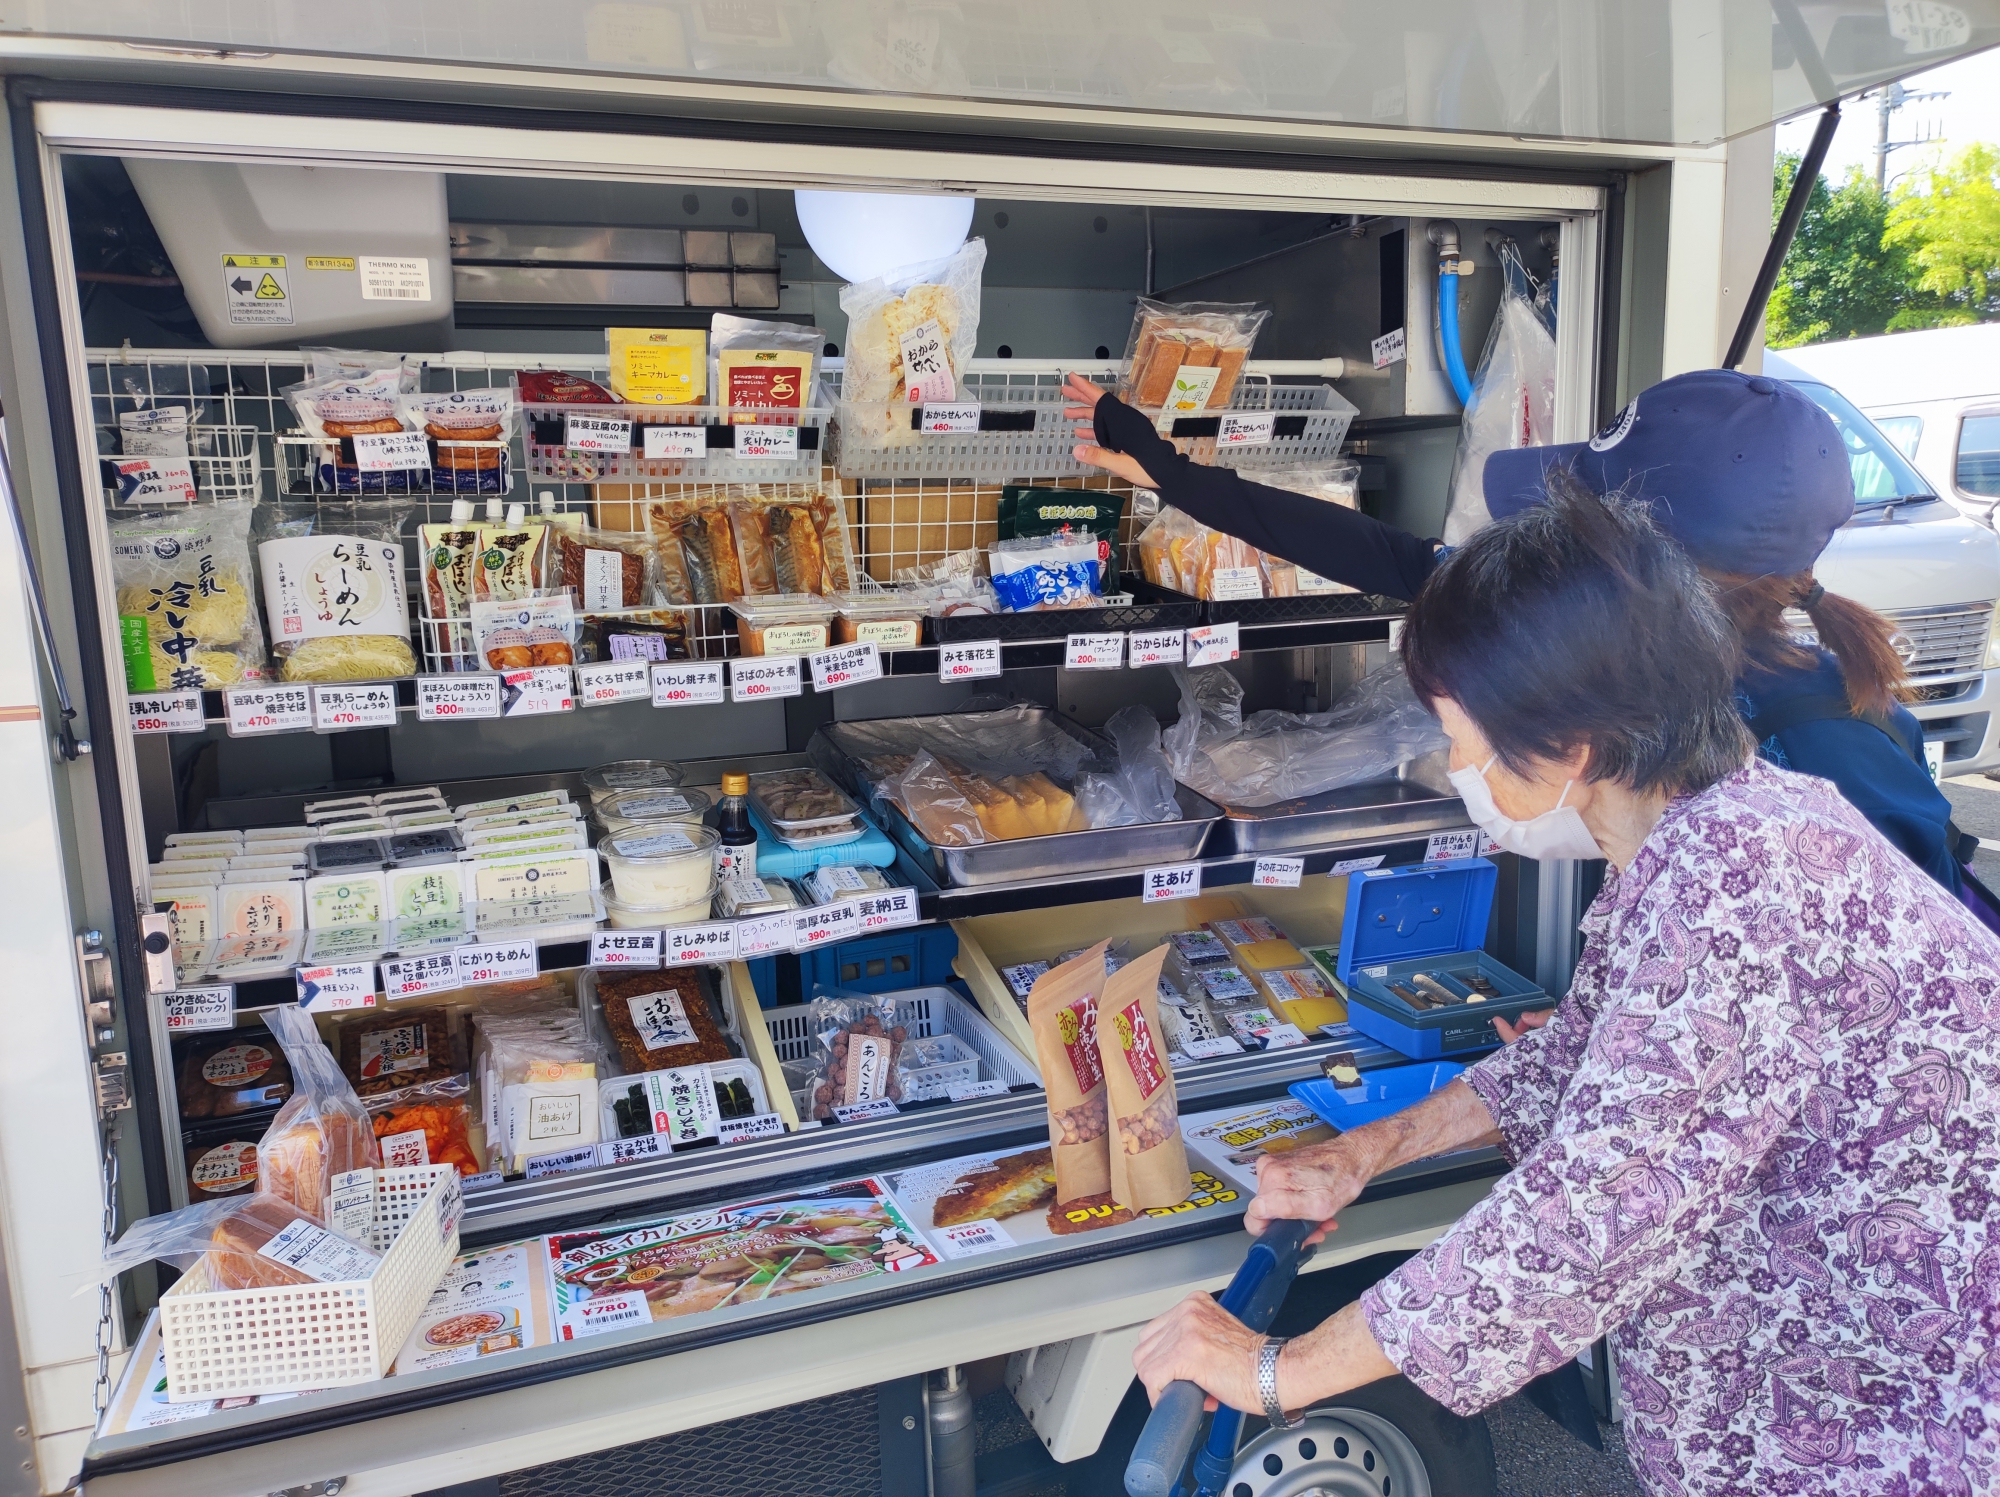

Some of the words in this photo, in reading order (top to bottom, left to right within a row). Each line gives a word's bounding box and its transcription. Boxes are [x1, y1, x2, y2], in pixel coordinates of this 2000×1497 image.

[908, 340, 938, 362] おから
[912, 355, 940, 373] せんべい
[925, 411, 976, 419] おからせんべい
[570, 419, 630, 432] 麻婆豆腐の素
[1224, 424, 1268, 434] きなこせんべい
[579, 440, 602, 448] 400円
[744, 437, 790, 446] 炙りカレー
[355, 544, 371, 571] 豆乳
[198, 554, 225, 598] 豆乳
[333, 544, 361, 626] らーめん
[315, 573, 333, 621] しょうゆ
[130, 620, 144, 655] 国産大豆
[147, 581, 206, 690] 冷し中華
[1071, 638, 1119, 646] 豆乳ドーナツ
[815, 647, 870, 665] まぼろしの味噌
[944, 649, 996, 662] みそ落花生
[1078, 655, 1096, 663] 200円
[1142, 653, 1160, 661] 240円
[825, 657, 864, 673] 米麦合わせ
[953, 665, 973, 675] 650円
[506, 672, 533, 685] 期間限定
[584, 671, 644, 686] まぐろ甘辛煮
[736, 665, 797, 681] さばのみそ煮
[827, 672, 850, 684] 690円
[657, 673, 716, 686] いわし銚子煮
[422, 683, 494, 692] まぼろしの味噌だれ
[596, 689, 620, 698] 650円
[747, 685, 770, 694] 600円
[233, 692, 305, 705] 豆乳もっちもち
[321, 692, 388, 703] 豆乳らーめん
[425, 693, 490, 702] 柚子こしょう入り
[667, 691, 691, 699] 490円
[265, 703, 306, 714] 焼きそば
[436, 704, 463, 714] 500円
[529, 700, 549, 710] 519
[562, 699, 571, 709] 円
[138, 719, 167, 729] 550円
[248, 716, 277, 726] 470円
[333, 713, 360, 723] 470円
[1433, 835, 1473, 845] 五目がんも
[1257, 863, 1301, 873] うの花コロッケ
[1152, 869, 1194, 888] 生あげ
[1262, 876, 1278, 884] 160円
[423, 877, 437, 903] 枝豆
[1155, 889, 1174, 897] 300円
[262, 895, 275, 926] にがり
[859, 895, 908, 916] 麦納豆
[796, 908, 854, 930] 濃厚な豆乳
[867, 916, 888, 926] 210円
[673, 931, 730, 947] さしみゆば
[808, 930, 830, 941] 390円
[599, 937, 654, 949] よせ豆富
[460, 949, 530, 966] にがりもめん
[605, 954, 630, 962] 300円
[681, 950, 705, 960] 690円
[389, 955, 452, 976] 黒ごま豆富
[303, 968, 333, 981] 期間限定
[403, 967, 453, 982] (2個パック)
[473, 969, 499, 980] 291円
[402, 982, 428, 993] 350円
[363, 996, 375, 1005] 円
[171, 1006, 226, 1015] (2個パック)
[167, 1016, 193, 1026] 291円
[1131, 1005, 1154, 1058] みそ
[380, 1039, 396, 1071] 生姜大根
[1079, 1024, 1102, 1081] 落花生
[1133, 1031, 1157, 1088] 落花生
[206, 1062, 242, 1071] 味わい
[208, 1067, 246, 1077] そのまま
[860, 1045, 875, 1099] あんころ
[540, 1102, 572, 1110] おいしい
[671, 1084, 698, 1139] 焼きしそ巻
[838, 1101, 890, 1115] あんころ豆
[538, 1111, 573, 1123] 油あげ
[720, 1117, 777, 1132] 鉄板焼きしそ巻き
[745, 1125, 779, 1134] (9本入り)
[391, 1142, 418, 1152] こだわり
[612, 1137, 657, 1150] ぶっかけ
[613, 1145, 658, 1158] 生姜大根
[530, 1151, 591, 1169] おいしい油揚げ
[197, 1162, 234, 1172] 味わい
[198, 1169, 239, 1181] そのまま
[566, 1212, 738, 1264] 剣先イカバジル
[946, 1228, 986, 1239] ¥160
[453, 1305, 472, 1313] next
[476, 1292, 525, 1307] generation
[582, 1302, 628, 1316] ¥780
